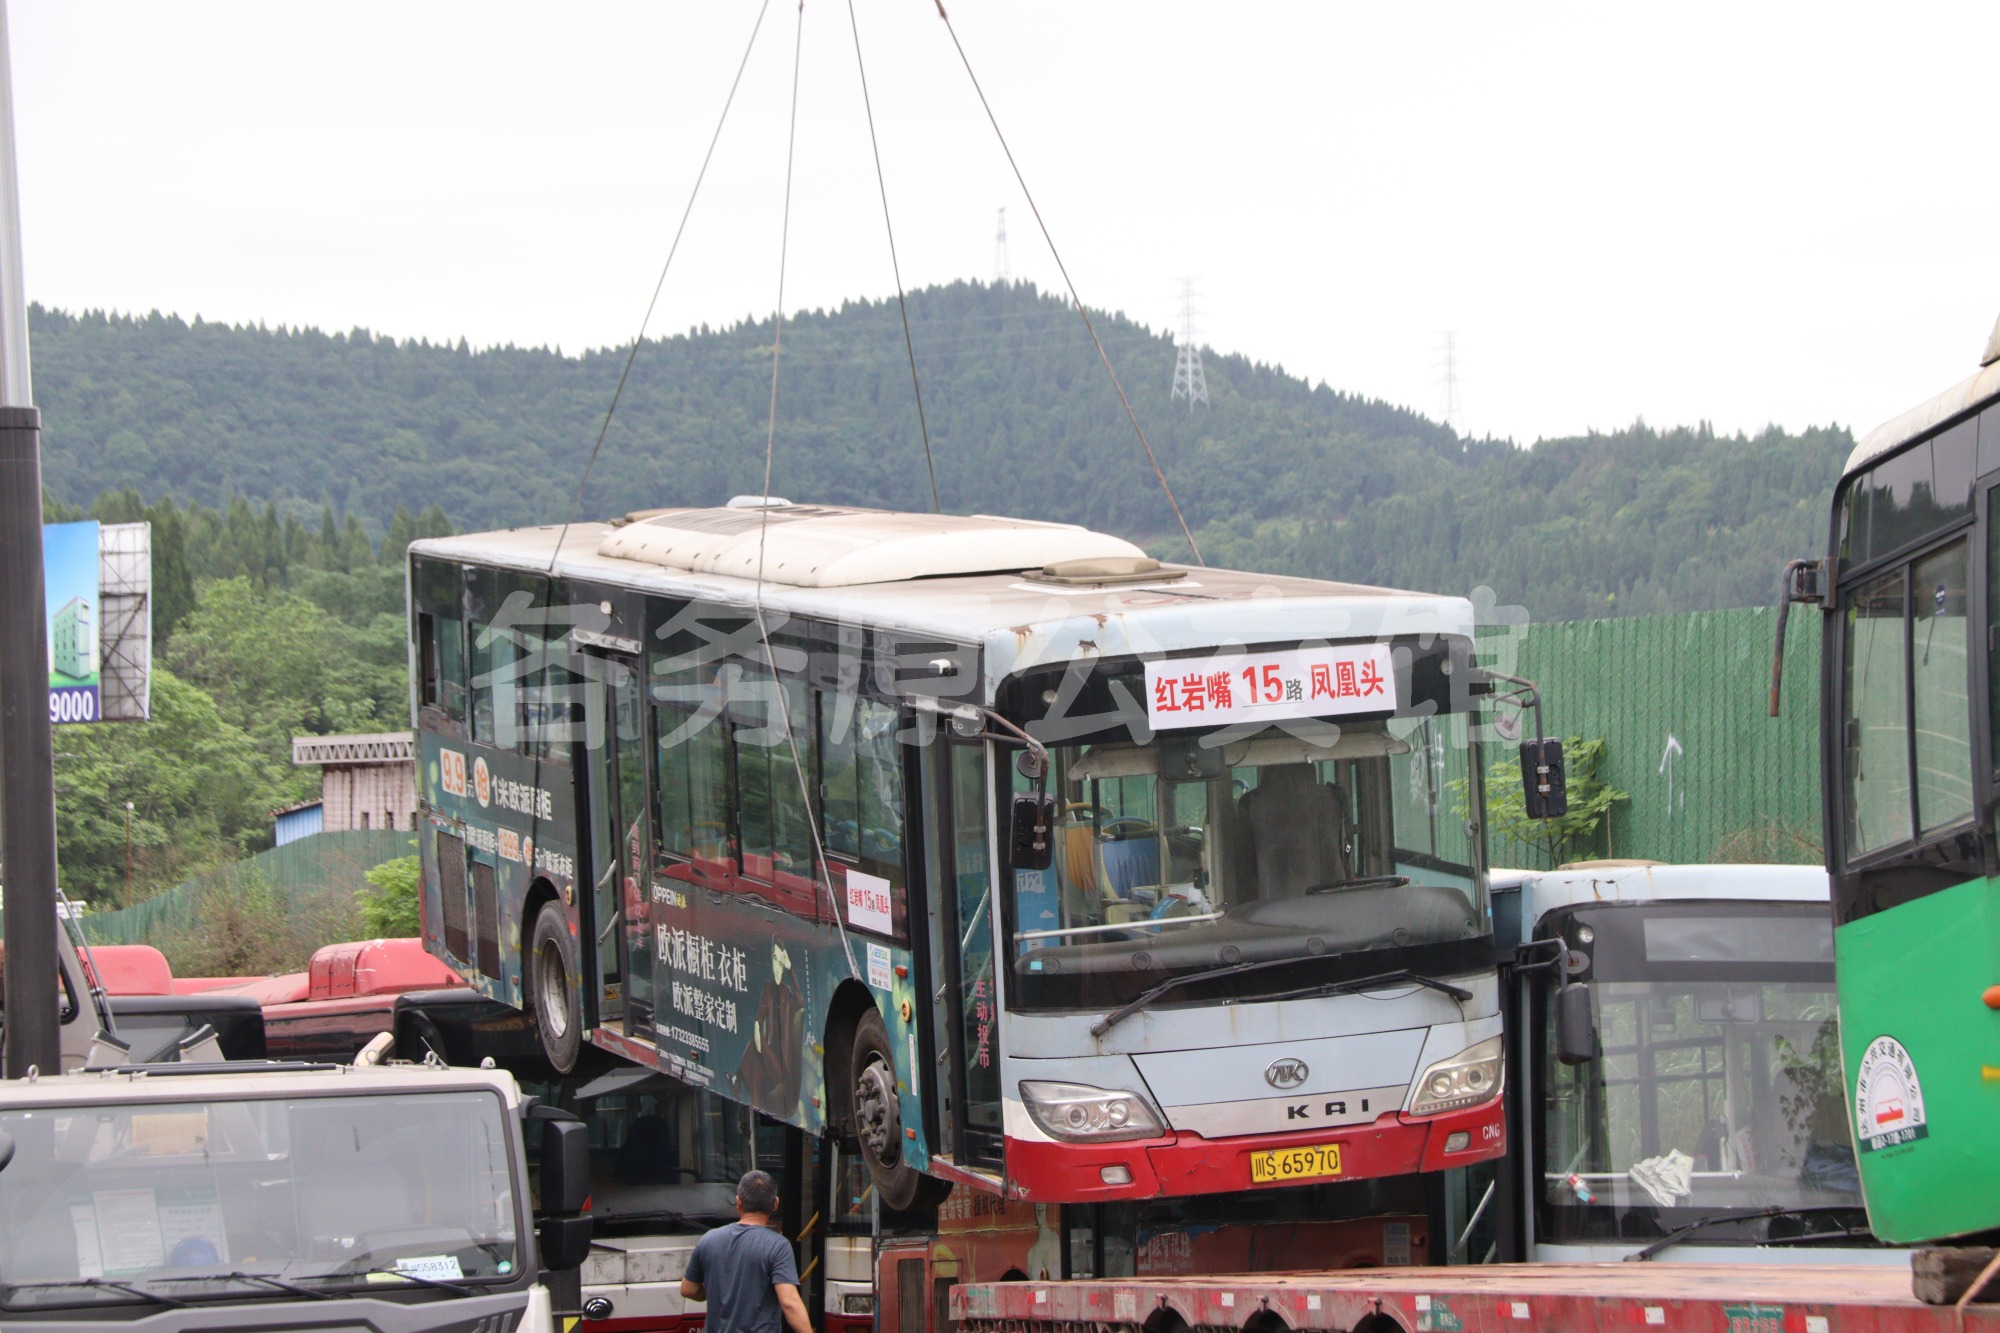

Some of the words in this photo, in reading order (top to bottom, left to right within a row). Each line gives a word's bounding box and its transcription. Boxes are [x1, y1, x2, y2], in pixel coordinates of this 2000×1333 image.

[50, 690, 94, 723] 9000
[1155, 671, 1233, 712] 红岩嘴
[1311, 658, 1384, 700] 凤凰头
[652, 885, 676, 907] OPPEIN
[657, 923, 715, 981] 欧派橱柜
[717, 943, 748, 992] 衣柜
[672, 981, 738, 1034] 欧派整家定制
[975, 980, 990, 1068] 主动投币
[1287, 1099, 1369, 1120] KAI
[1482, 1122, 1500, 1140] CNG
